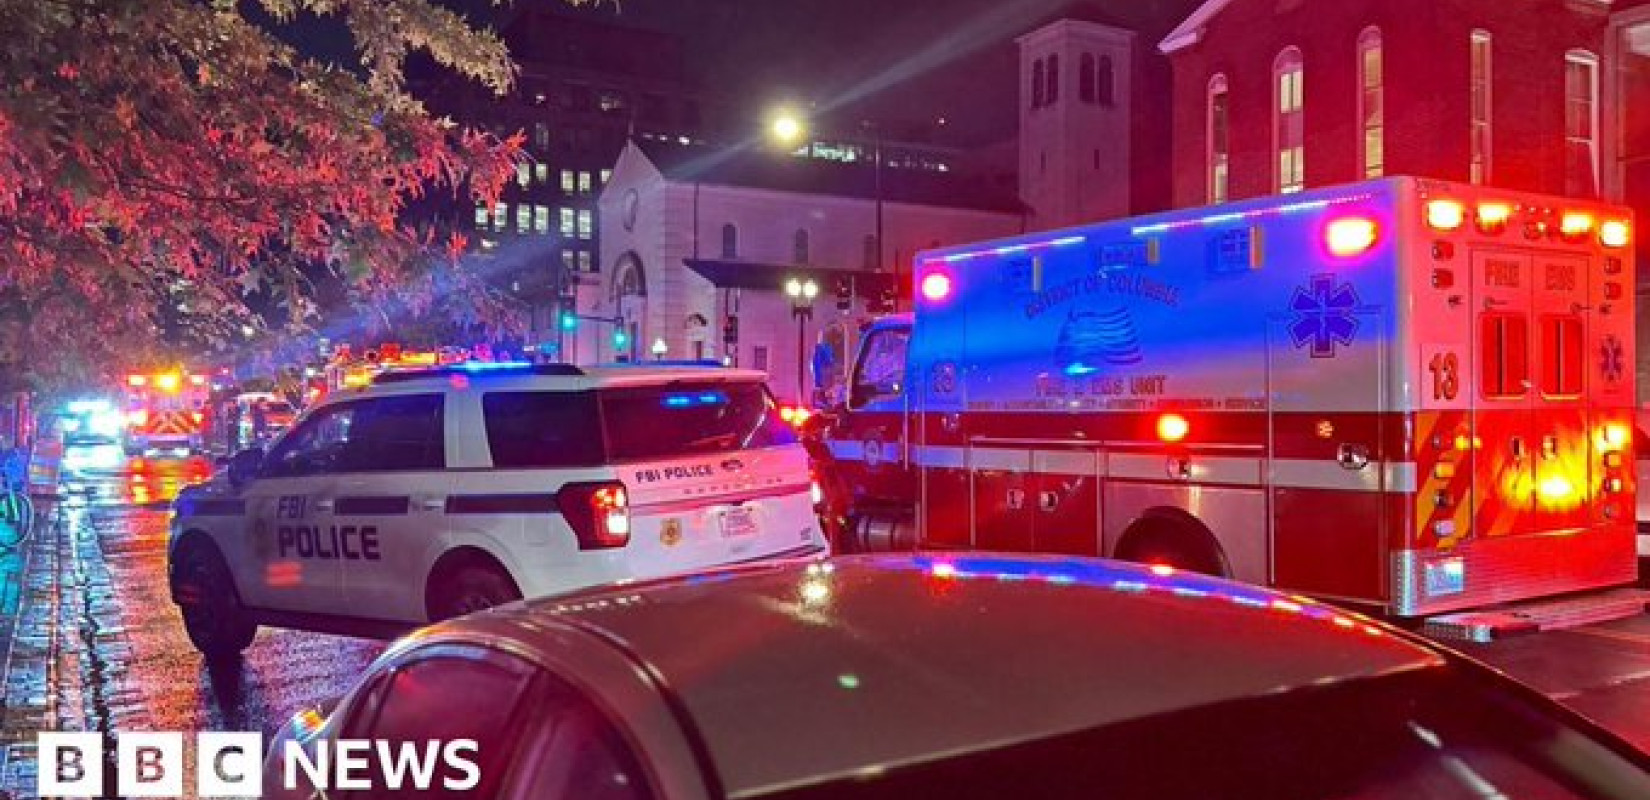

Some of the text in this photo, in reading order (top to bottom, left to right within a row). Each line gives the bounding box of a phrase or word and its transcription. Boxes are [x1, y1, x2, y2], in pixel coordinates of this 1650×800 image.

[1485, 259, 1576, 291] FIRE EMS
[1130, 374, 1166, 395] UNIT
[1429, 352, 1459, 401] 13
[635, 469, 661, 483] FBI
[664, 464, 714, 480] POLICE
[277, 495, 307, 519] FBI
[278, 525, 382, 560] POLICE
